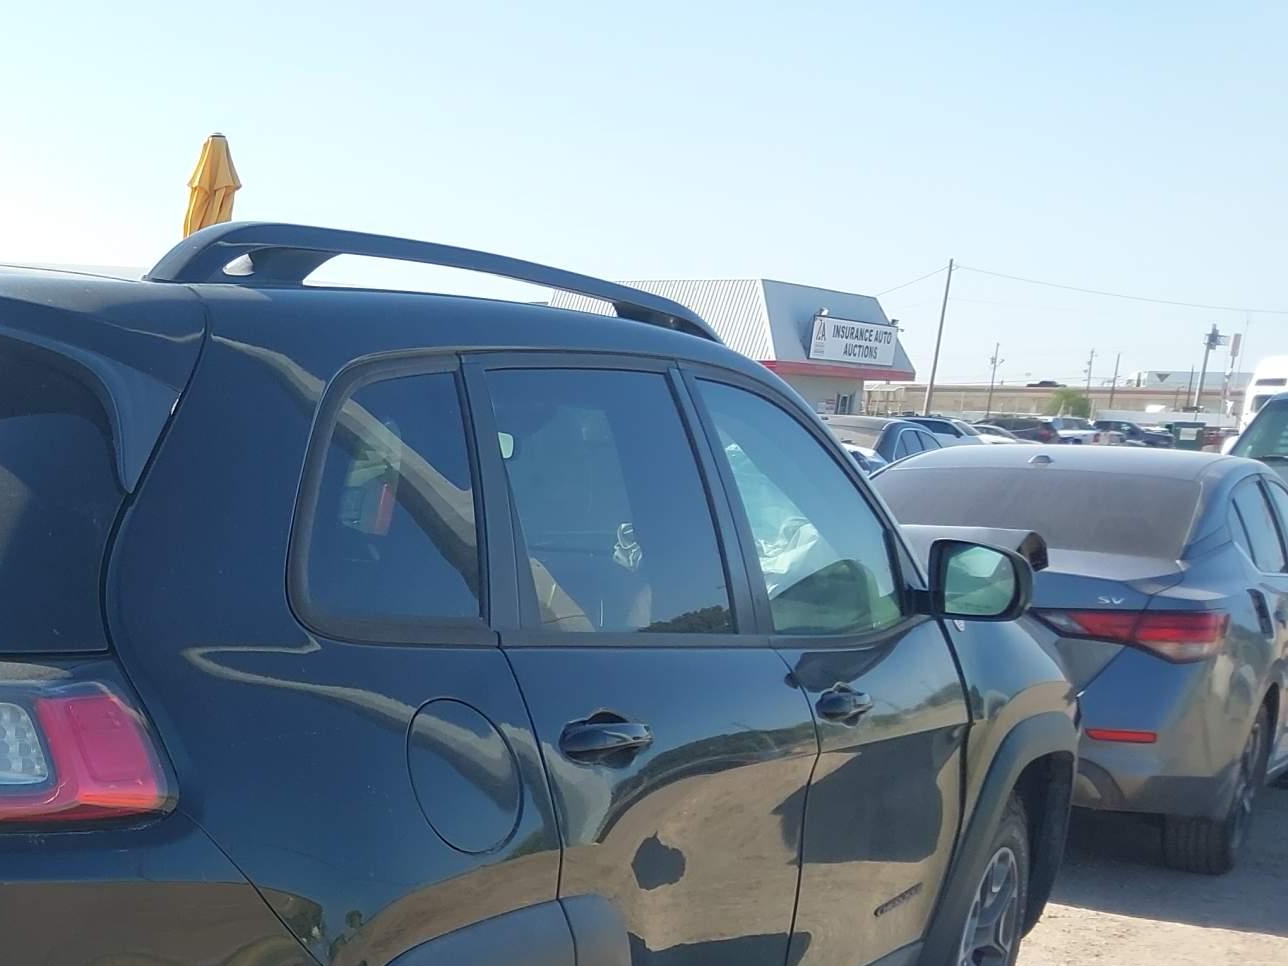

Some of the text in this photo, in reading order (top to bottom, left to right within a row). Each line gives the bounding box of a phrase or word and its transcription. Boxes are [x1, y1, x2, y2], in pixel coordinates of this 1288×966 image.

[832, 324, 874, 342] INSURANCE
[873, 330, 892, 345] AUTO
[842, 343, 878, 360] AUCTIONS
